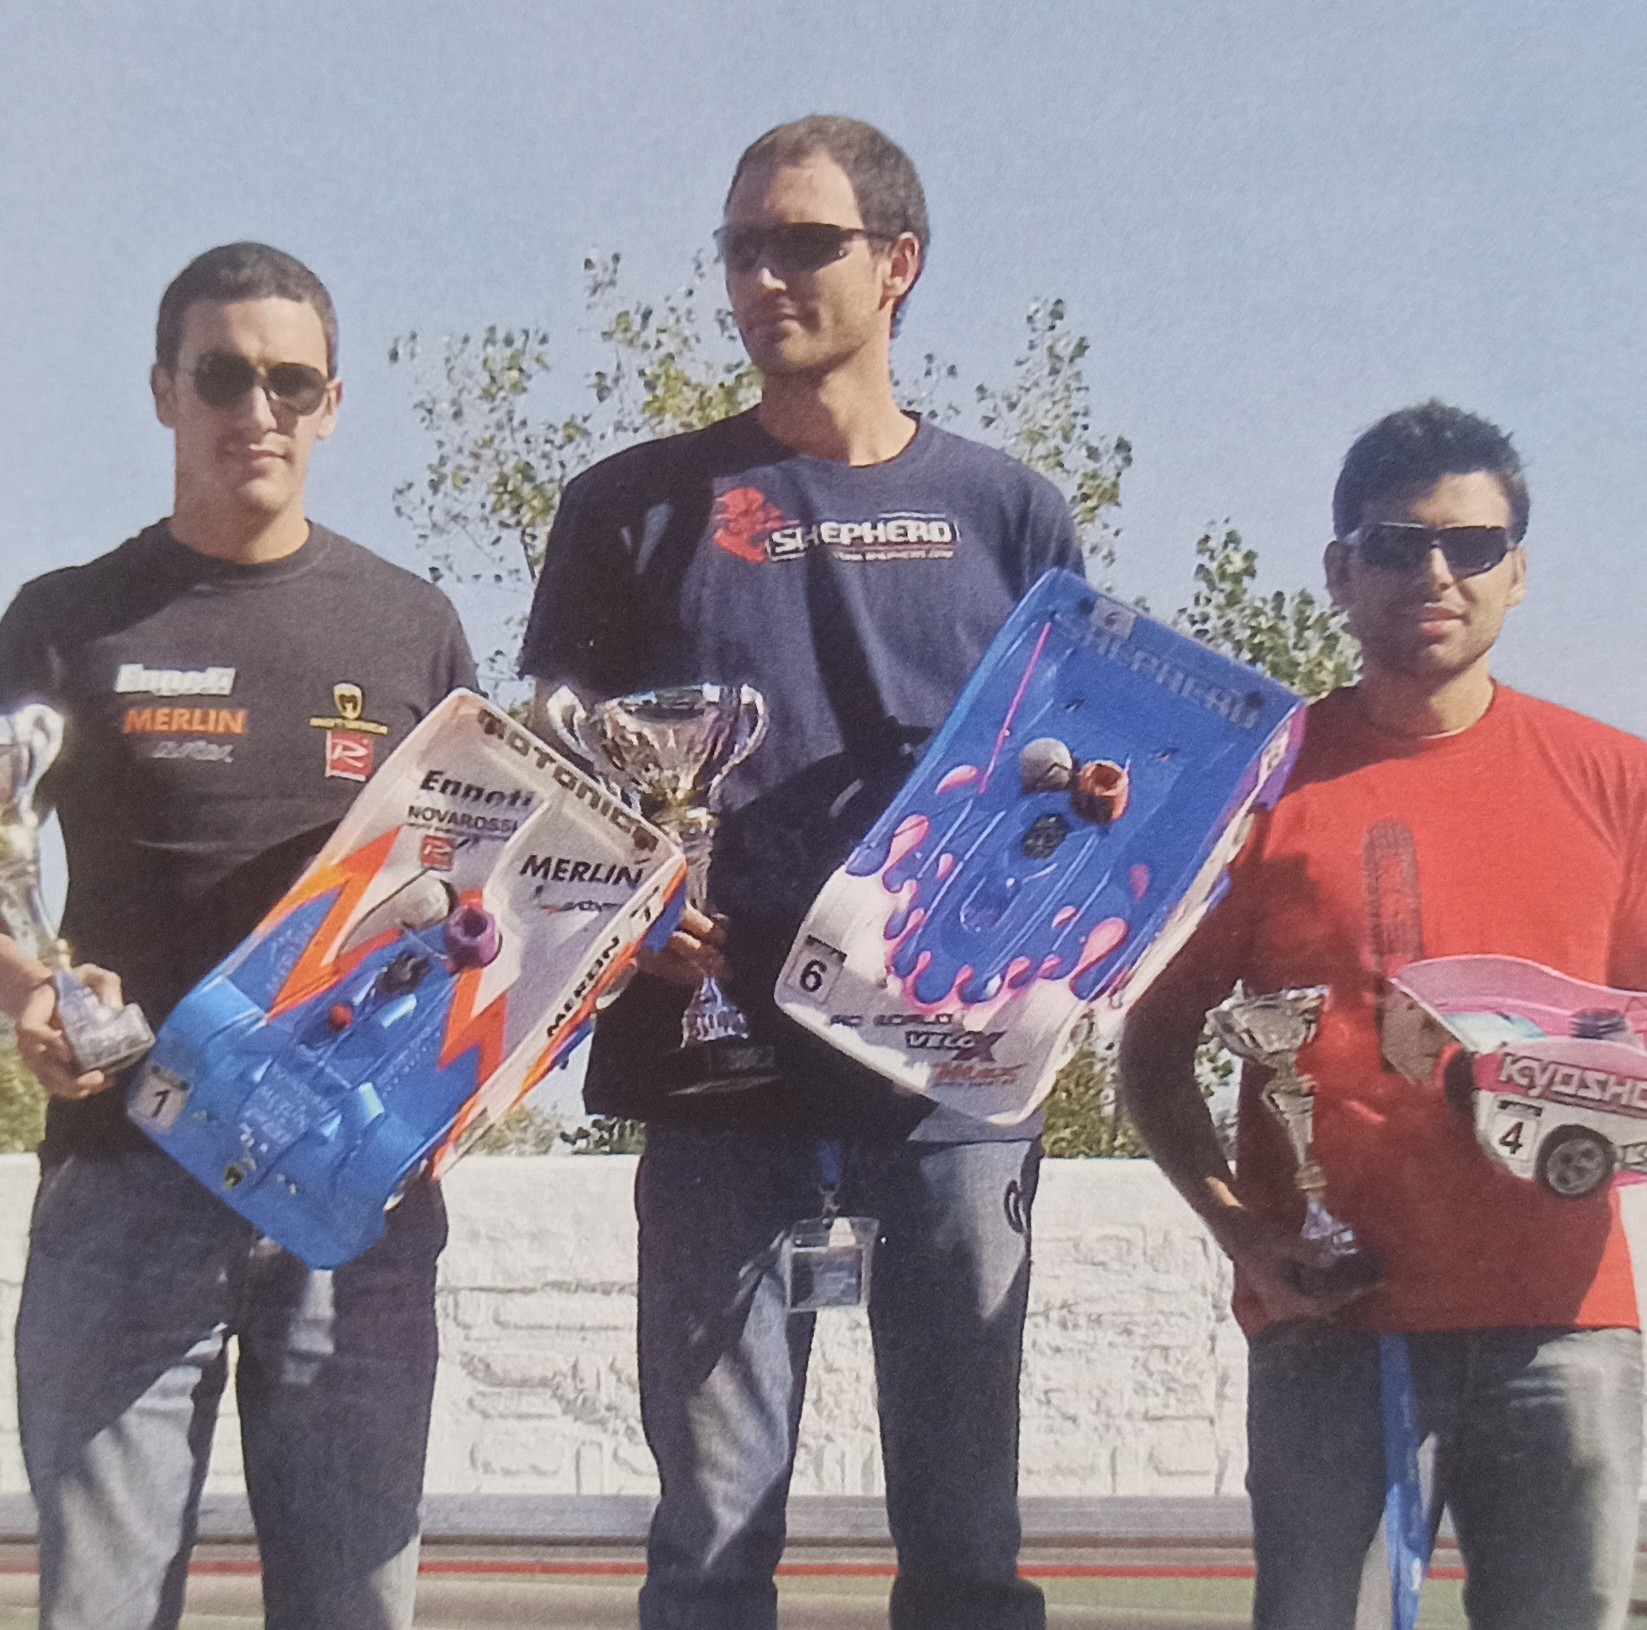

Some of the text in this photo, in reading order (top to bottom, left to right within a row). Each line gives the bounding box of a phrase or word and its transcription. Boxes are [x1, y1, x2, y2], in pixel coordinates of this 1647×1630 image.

[771, 519, 952, 553] SHEPHERD
[123, 707, 247, 735] MERLIN
[407, 805, 518, 834] NOVAROSSI
[519, 854, 643, 886] MERLIN
[799, 958, 828, 993] 6
[1499, 1121, 1524, 1155] 4
